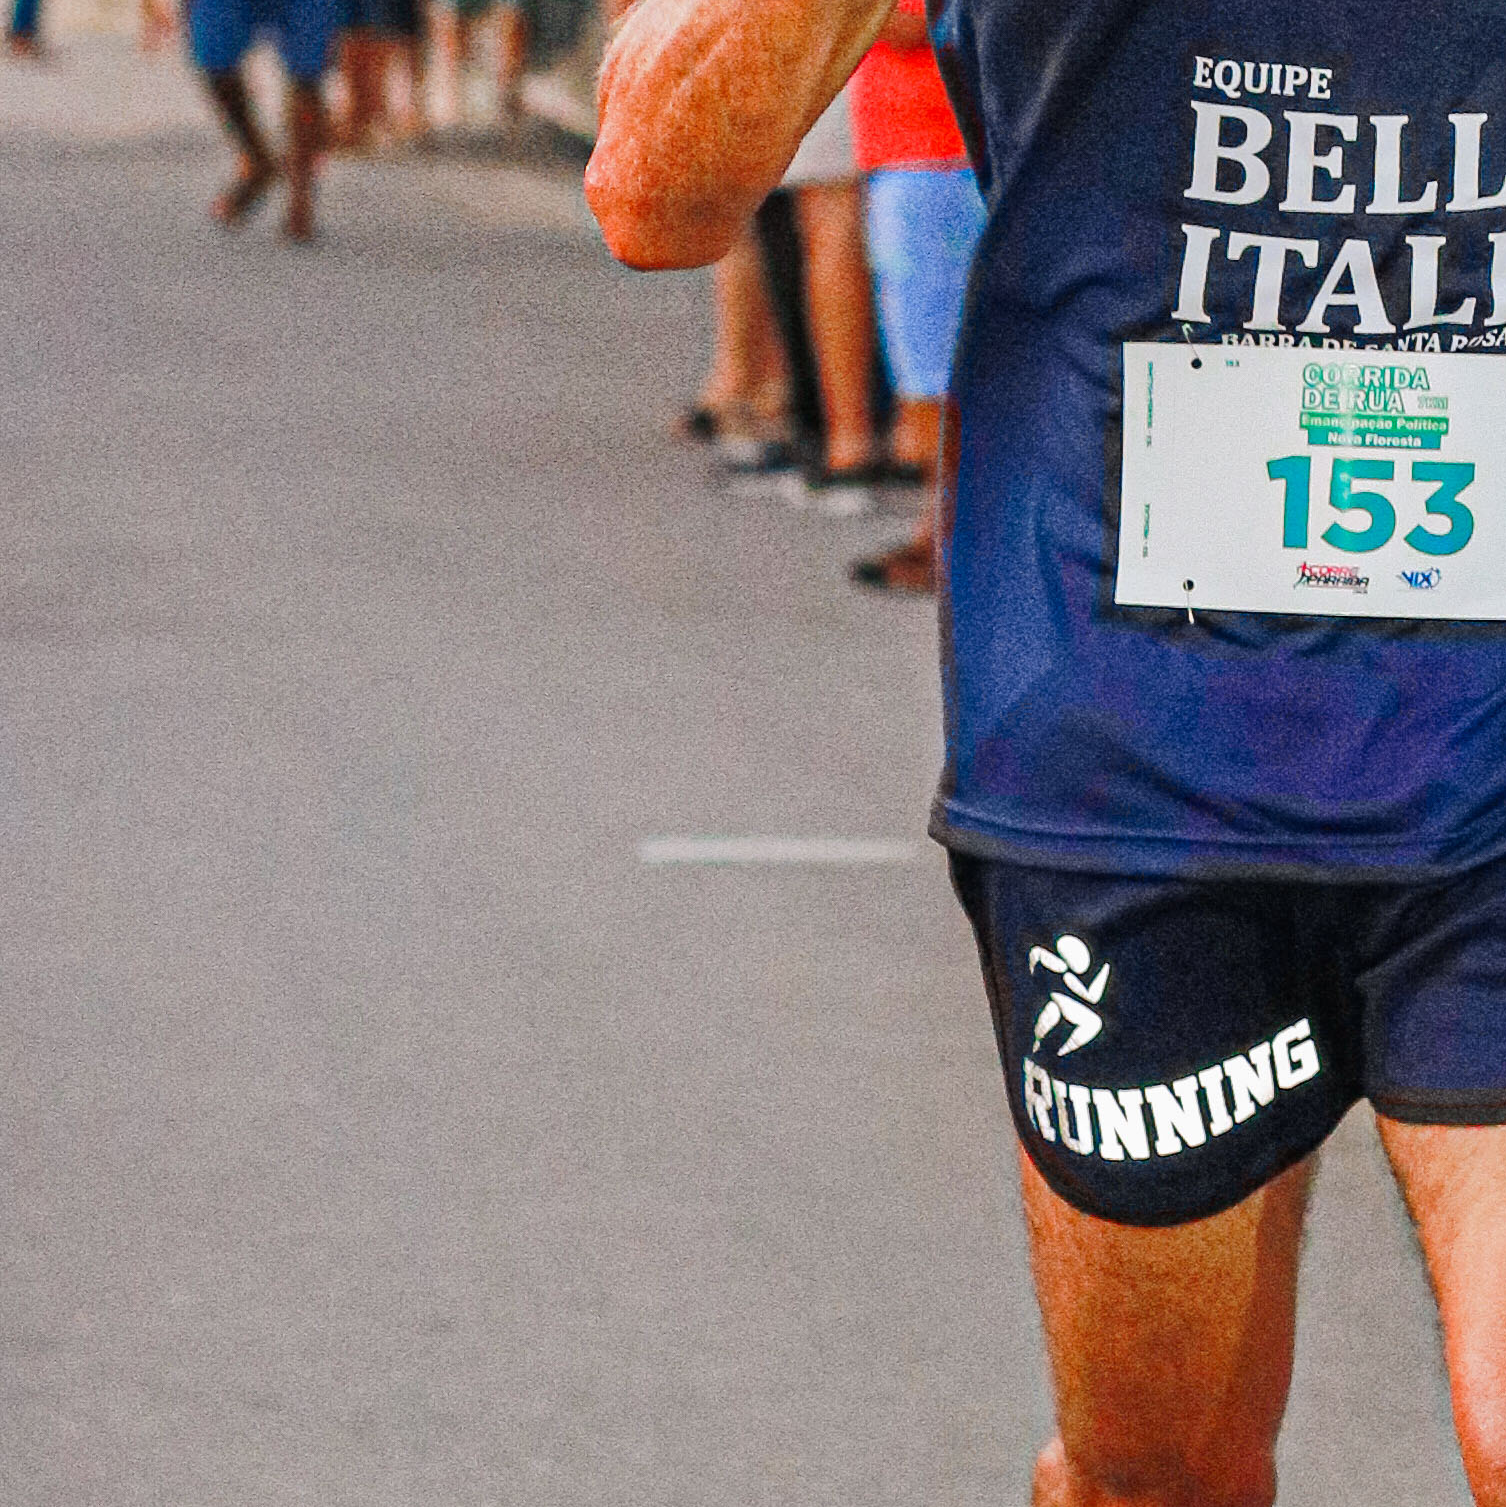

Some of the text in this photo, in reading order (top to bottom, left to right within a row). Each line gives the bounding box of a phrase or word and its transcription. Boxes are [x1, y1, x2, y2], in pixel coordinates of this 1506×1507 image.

[1193, 55, 1333, 100] EQUIPE
[1303, 362, 1430, 391] CORRIDA
[1302, 387, 1340, 410] DE
[1349, 390, 1406, 414] RUA
[1302, 413, 1393, 430] Emancpação
[1364, 433, 1422, 448] Floresta
[1266, 455, 1476, 556] 153
[1023, 1018, 1320, 1160] RUNNING
